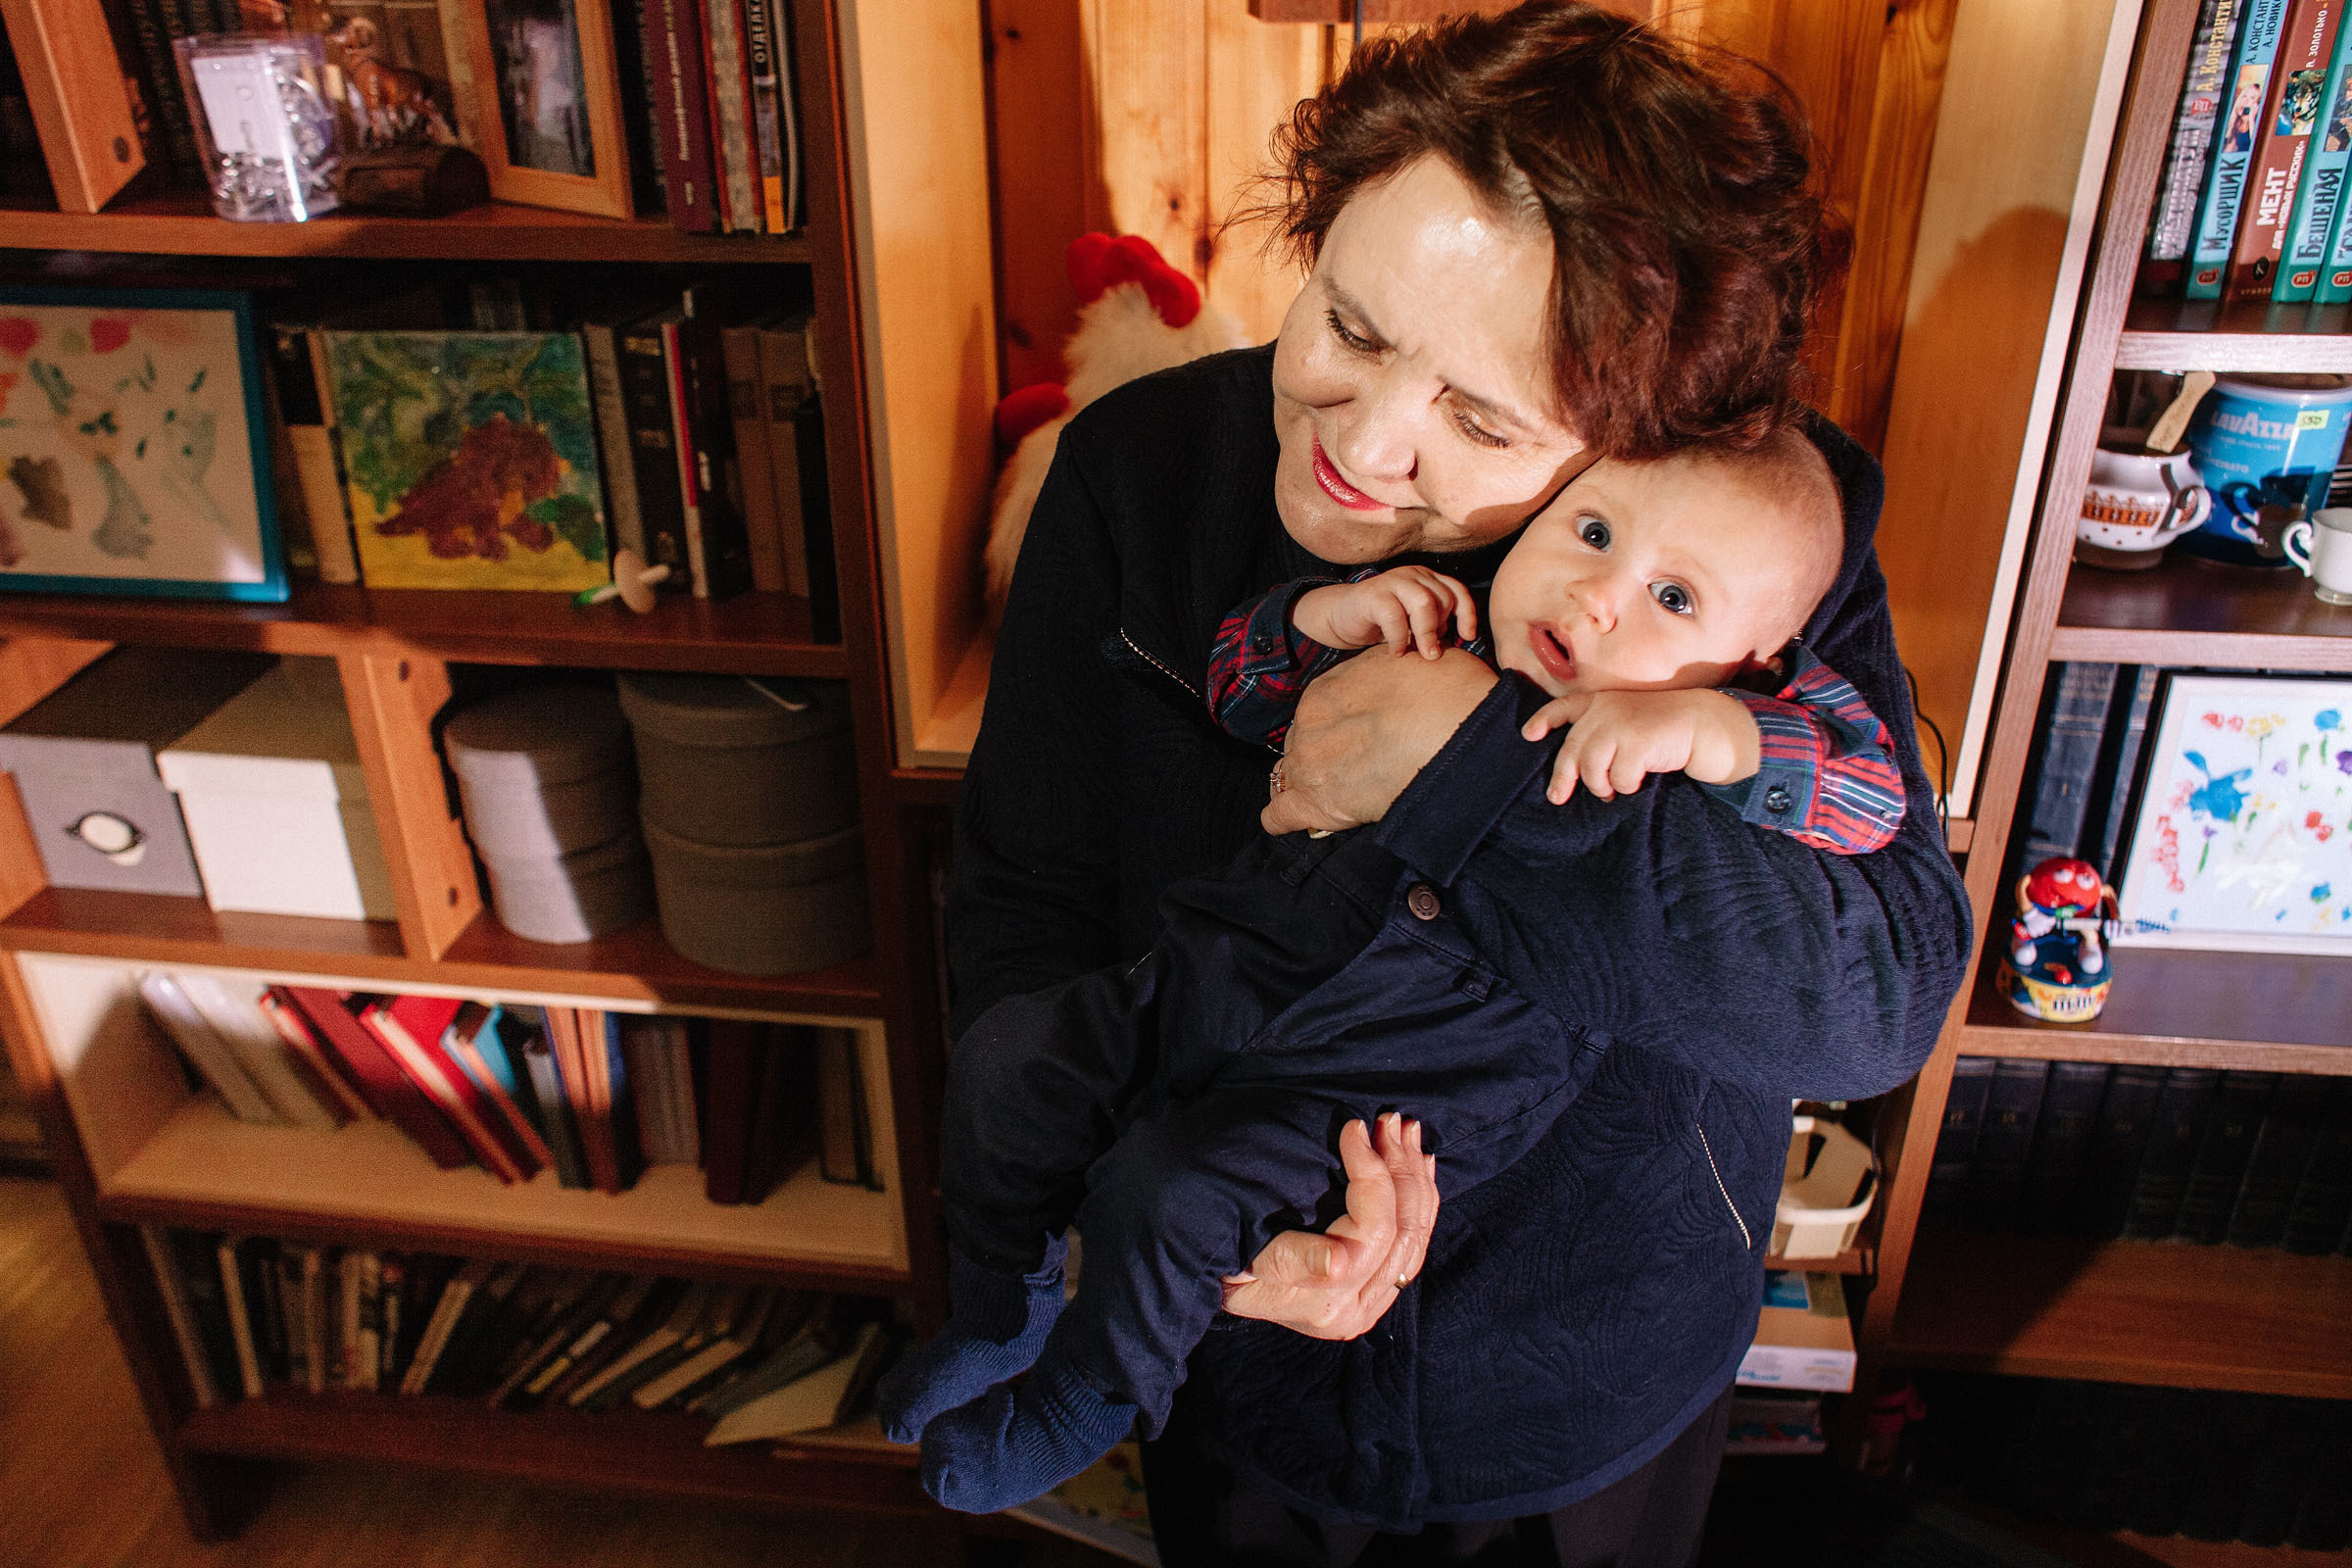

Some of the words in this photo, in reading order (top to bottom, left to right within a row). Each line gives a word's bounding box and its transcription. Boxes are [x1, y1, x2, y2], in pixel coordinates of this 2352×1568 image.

[2266, 0, 2282, 36] НОВИК
[2262, 38, 2274, 48] А.
[2308, 10, 2328, 57] ЗОЛОТЬКО
[2245, 54, 2257, 65] А.
[2196, 76, 2215, 92] А.
[2256, 167, 2287, 226] МЕНТ
